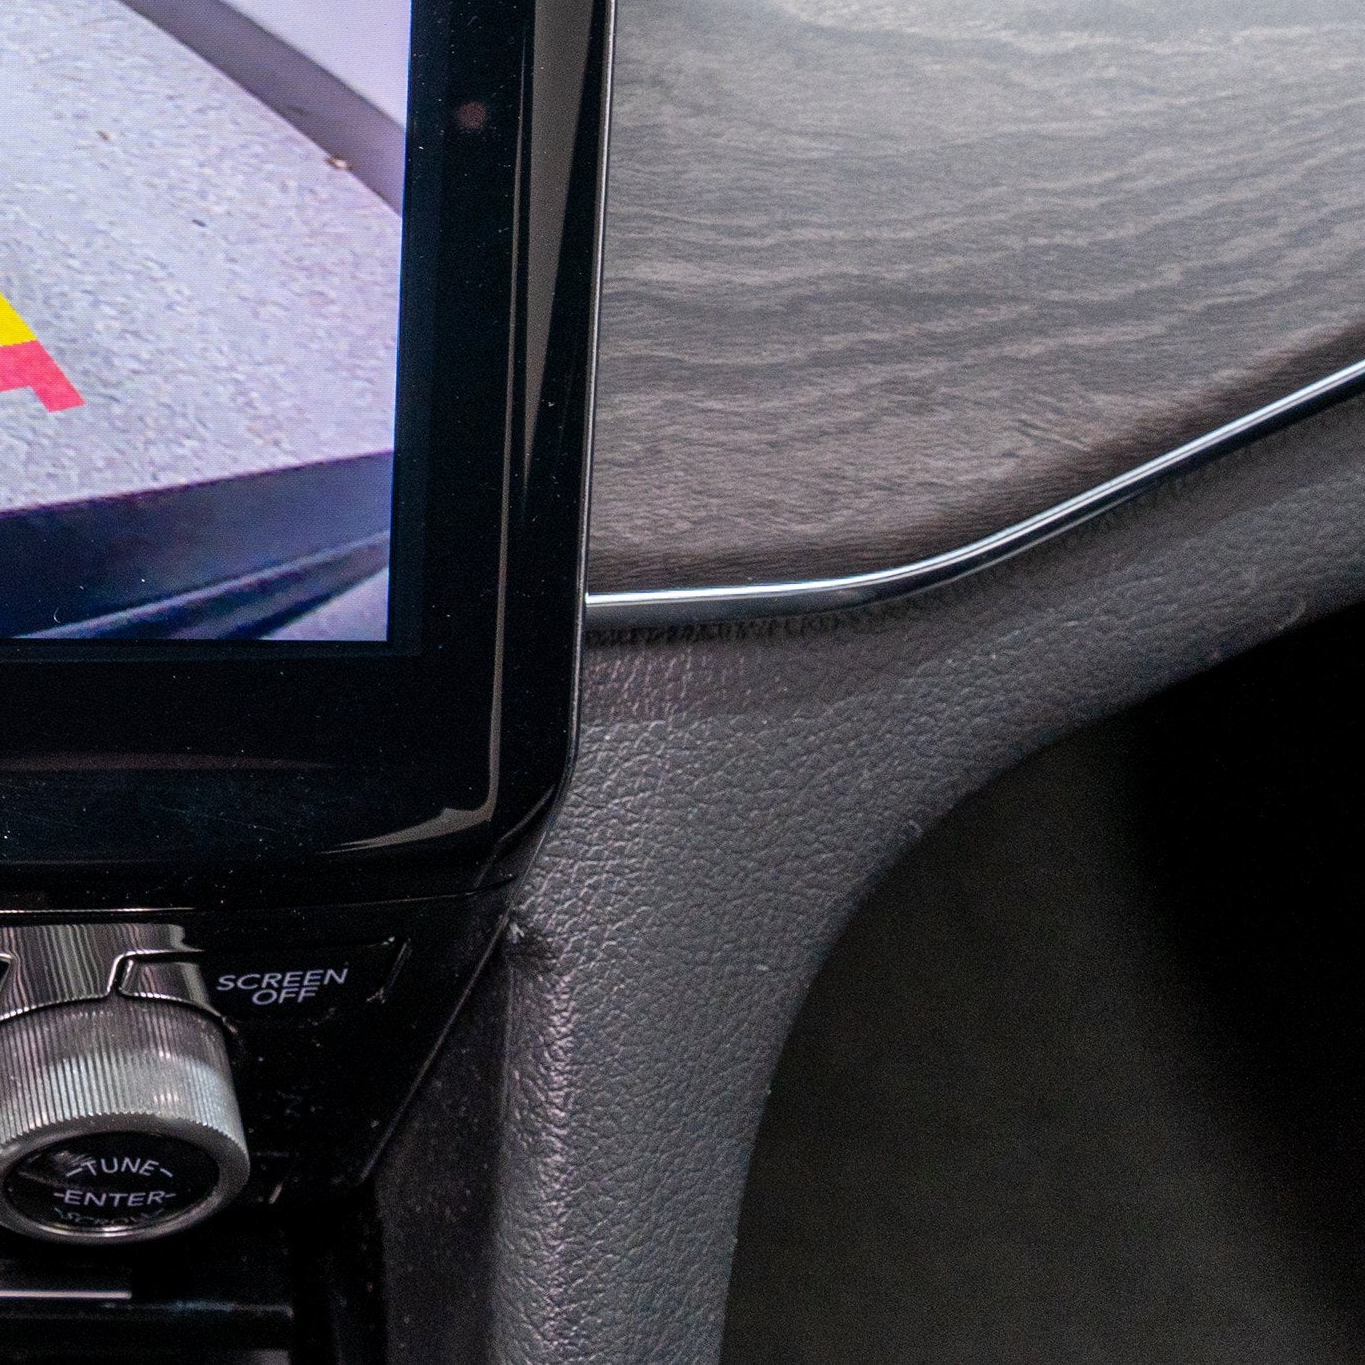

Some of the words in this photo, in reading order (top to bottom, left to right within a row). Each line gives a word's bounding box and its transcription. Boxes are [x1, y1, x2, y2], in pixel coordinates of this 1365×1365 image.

[216, 968, 349, 991] SCREEN
[251, 987, 319, 1006] OFF
[81, 1157, 160, 1176] TUNE
[64, 1189, 166, 1207] ENTER
